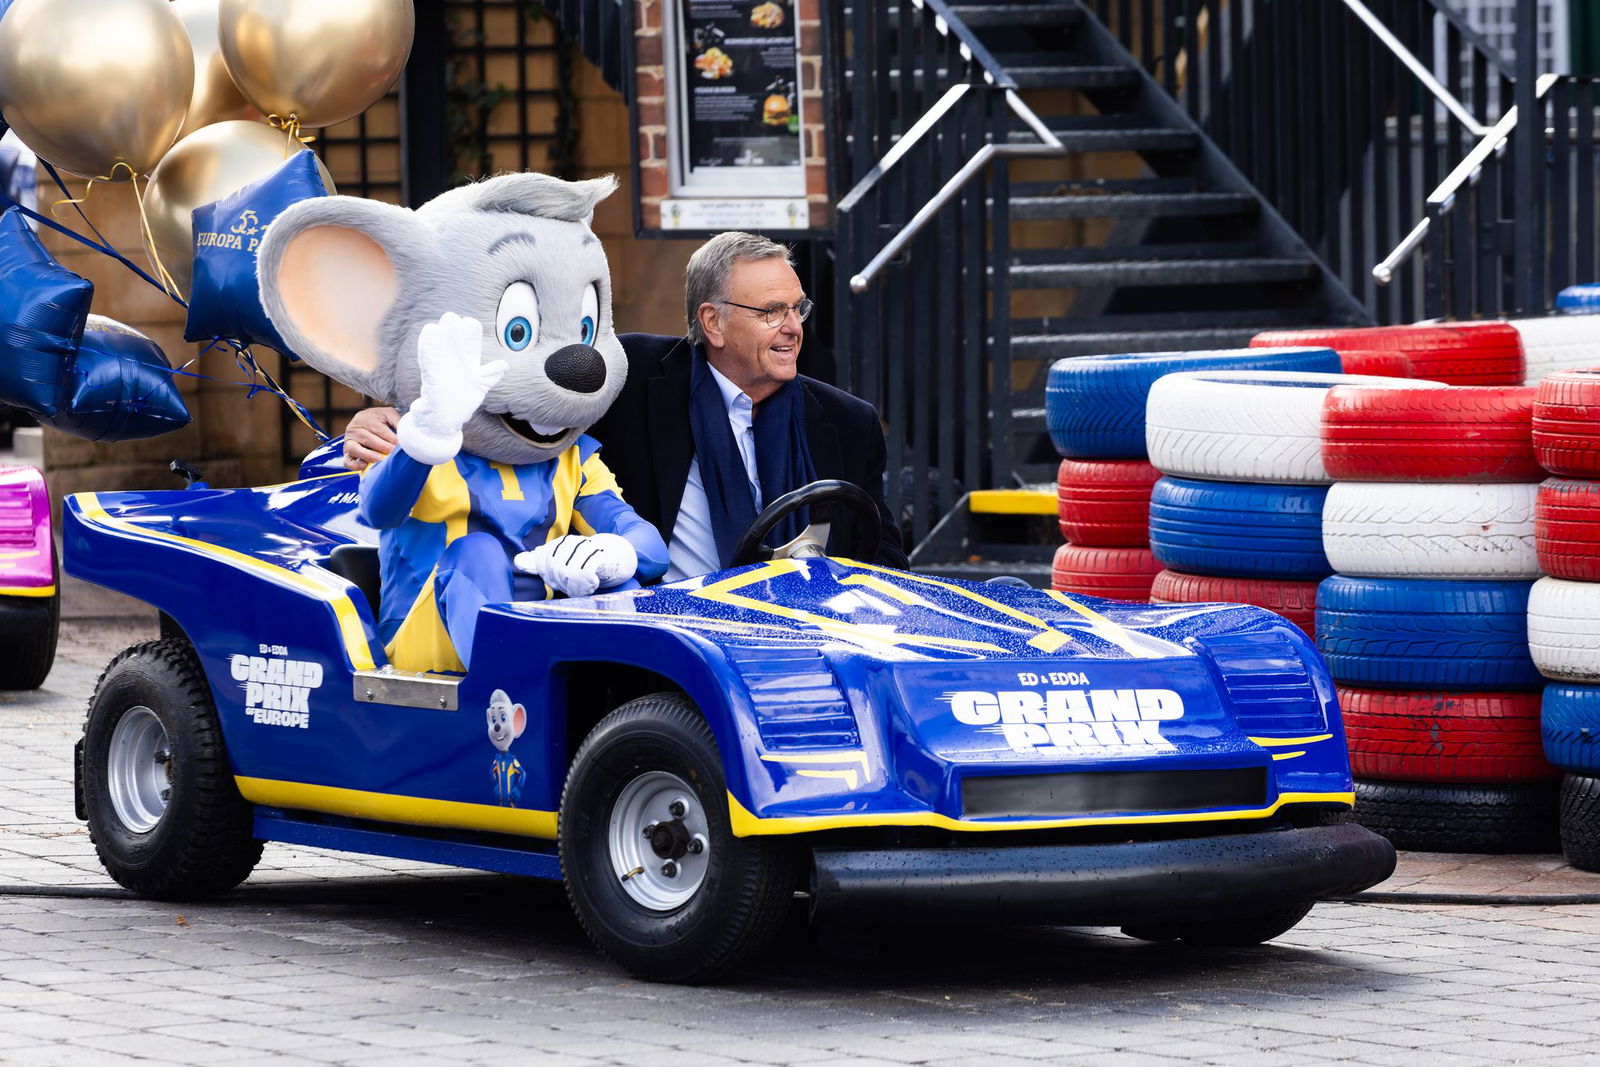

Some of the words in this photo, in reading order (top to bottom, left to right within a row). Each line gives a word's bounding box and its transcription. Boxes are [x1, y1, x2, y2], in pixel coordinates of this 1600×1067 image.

[197, 232, 242, 250] EUROPA
[229, 653, 324, 688] GRAND
[1017, 672, 1039, 686] ED
[1040, 675, 1049, 684] &
[1051, 672, 1090, 686] EDDA
[244, 682, 311, 713] PRIX
[948, 689, 1185, 725] GRAND
[253, 709, 310, 729] EUROPE
[1001, 721, 1173, 748] PRIX
